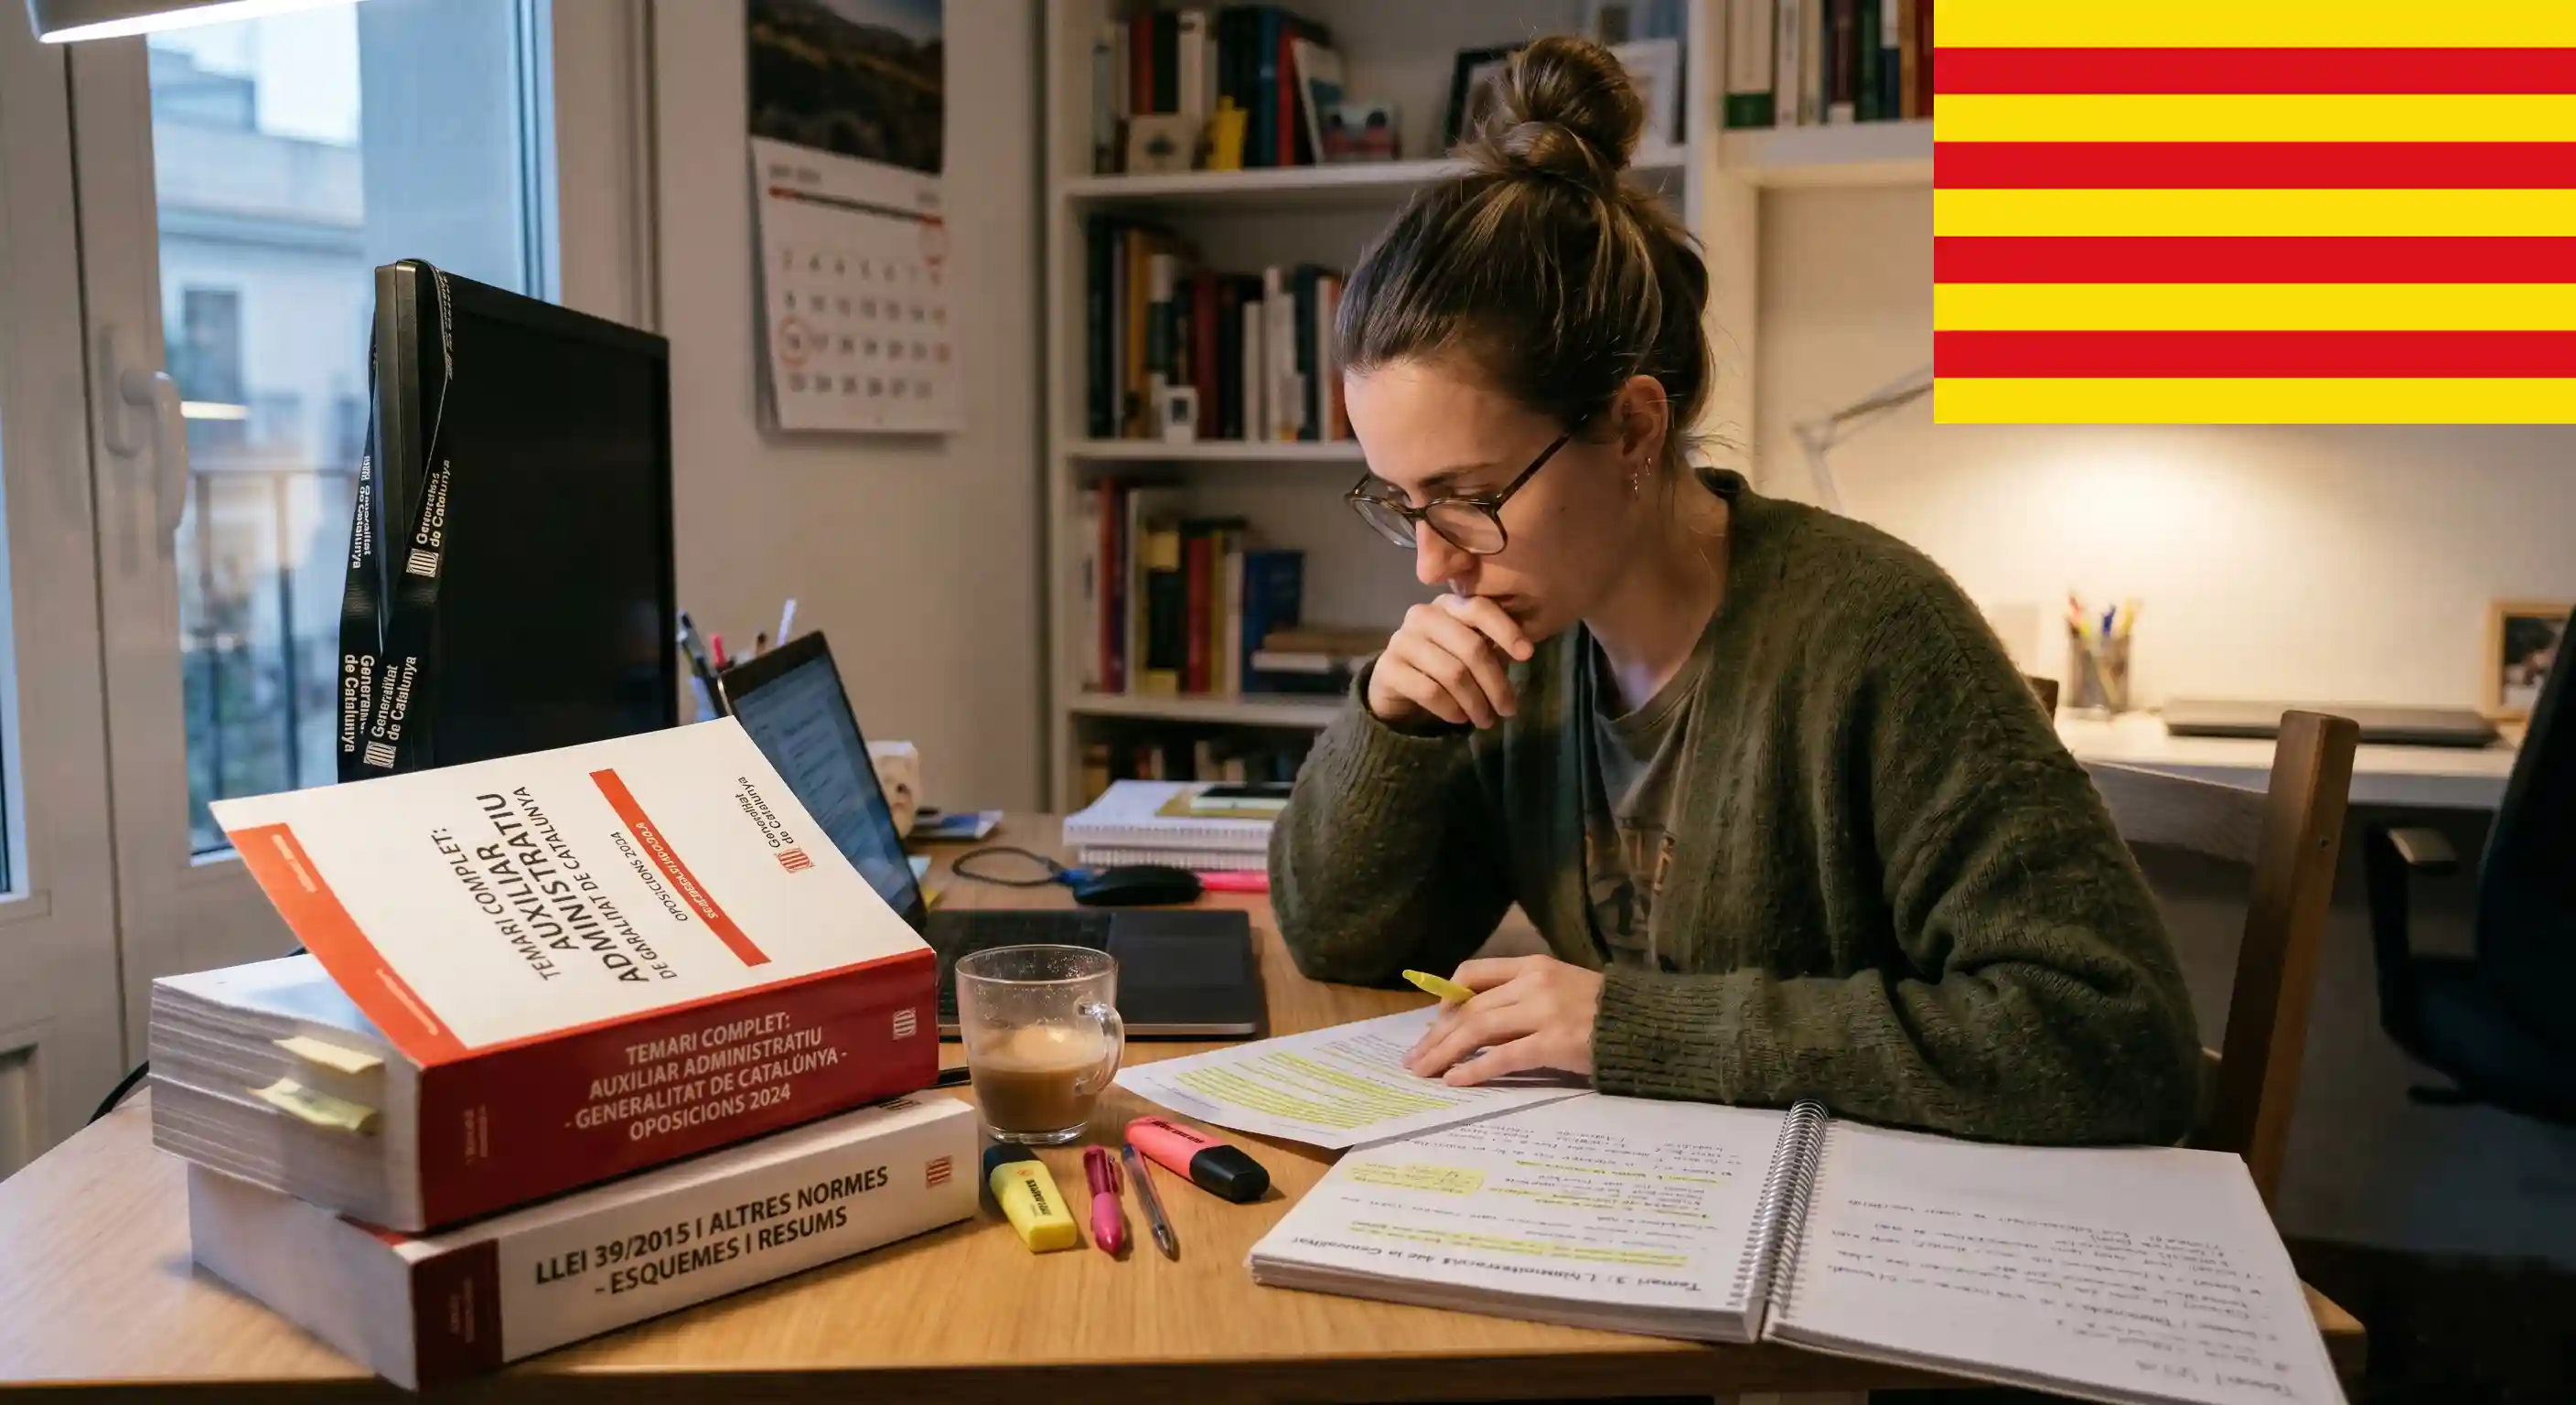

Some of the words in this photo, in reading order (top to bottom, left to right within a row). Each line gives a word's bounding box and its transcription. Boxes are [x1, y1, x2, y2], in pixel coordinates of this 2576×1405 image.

[344, 654, 359, 673] de
[386, 724, 401, 741] de
[512, 786, 581, 870] CATALUNYA
[431, 826, 505, 916] COMPLET:
[476, 793, 650, 982] ADMINISTRATIU
[476, 842, 580, 950] AUXILIAR
[574, 872, 599, 891] DE
[629, 859, 688, 922] OPOSICIONS
[495, 918, 562, 981] TEMARI
[651, 960, 678, 980] DE
[588, 1062, 679, 1100] AUXILIAR
[683, 1026, 822, 1078] ADMINISTRATIU
[626, 1032, 697, 1066] TEMARI
[701, 1012, 791, 1048] COMPLET:
[574, 1079, 706, 1130] GENERALITAT
[710, 1072, 735, 1096] DE
[629, 1093, 746, 1142] OPOSICIONS
[749, 1082, 791, 1110] 2024
[536, 1247, 587, 1284] LLEI
[594, 1221, 691, 1269] 39/2015
[695, 1216, 703, 1239] I
[708, 1193, 792, 1237] ALTRES
[797, 1164, 889, 1211] NORMES
[610, 1237, 740, 1294] ESQUEMES
[746, 1234, 752, 1254] I
[758, 1206, 848, 1250] RESUMS
